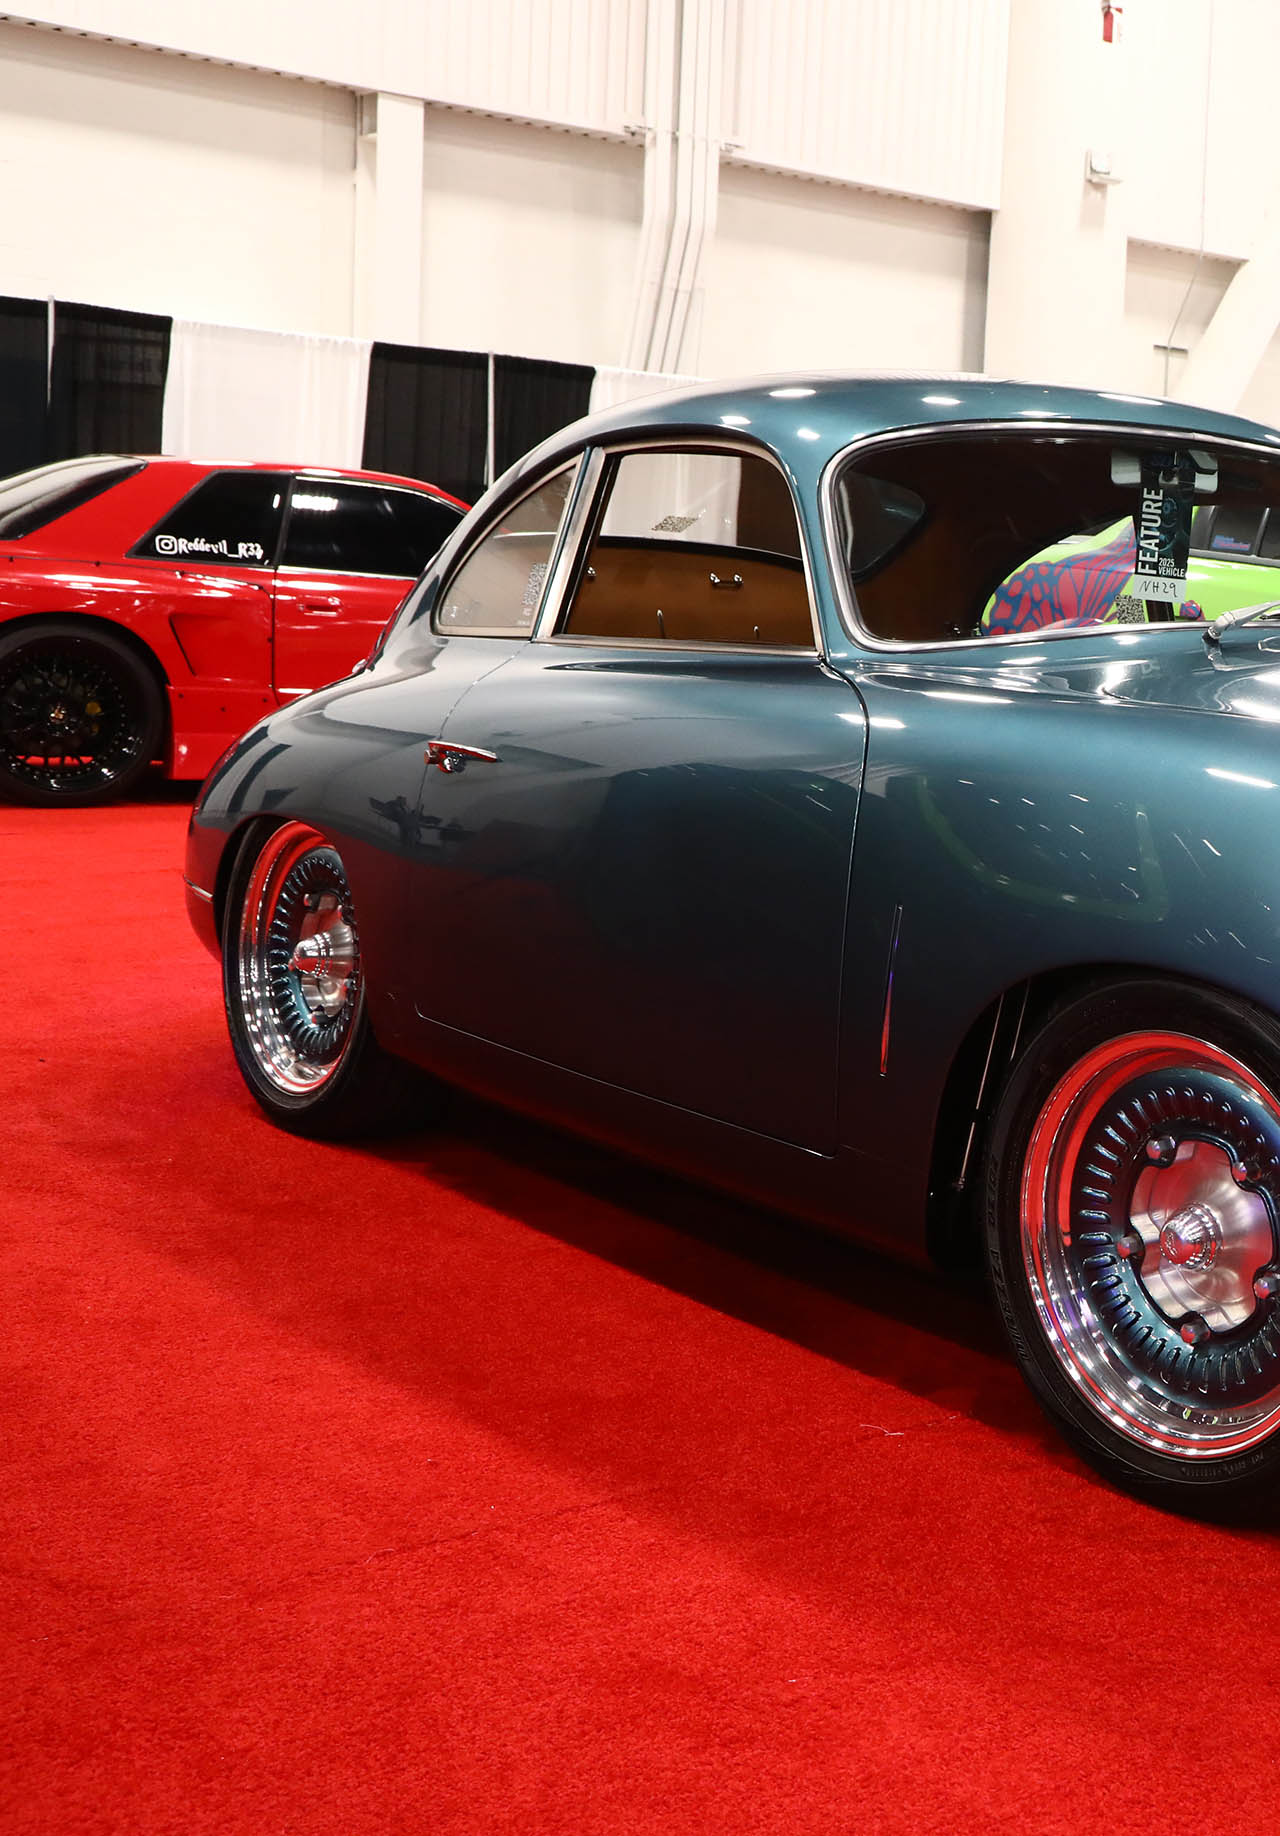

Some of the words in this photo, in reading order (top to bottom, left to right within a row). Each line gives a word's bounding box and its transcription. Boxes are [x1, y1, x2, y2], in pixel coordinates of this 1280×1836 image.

[1137, 488, 1164, 575] FEATURE
[1159, 558, 1175, 568] 2025
[1158, 566, 1185, 578] VEHICLE
